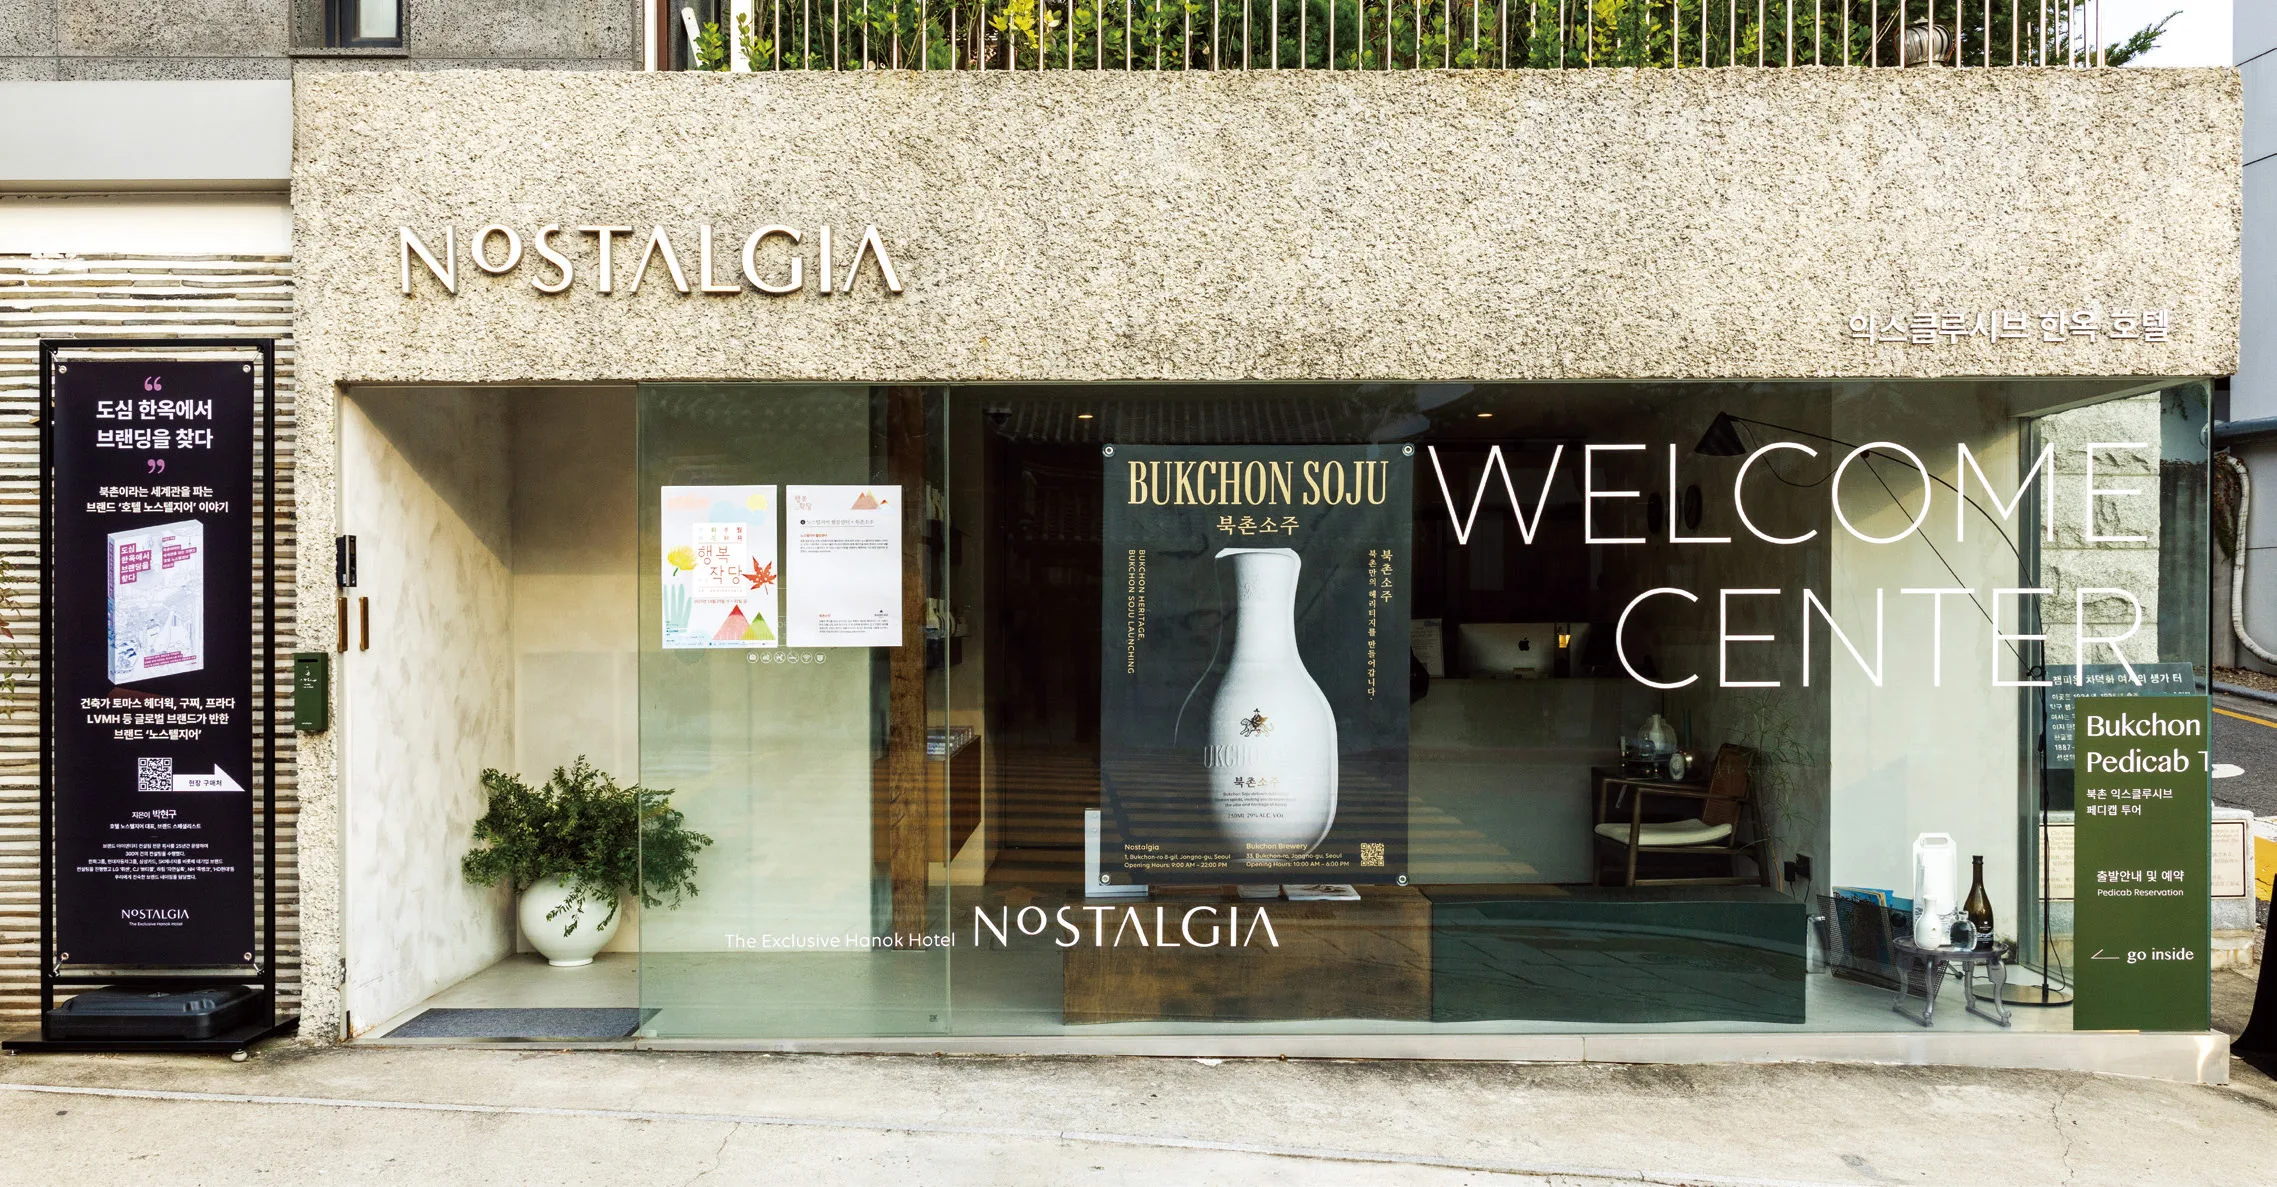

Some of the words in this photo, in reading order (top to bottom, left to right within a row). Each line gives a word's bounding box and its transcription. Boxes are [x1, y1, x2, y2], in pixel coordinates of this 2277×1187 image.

[400, 223, 902, 295] NOSTALGIA
[1849, 311, 2029, 346] 익스클루시브
[2040, 309, 2099, 344] 한옥
[2110, 308, 2169, 344] 호텔
[96, 399, 133, 420] 도심
[138, 399, 213, 420] 한옥에서
[96, 428, 171, 450] 브랜딩을
[175, 428, 214, 450] 찾다
[99, 486, 149, 498] 북촌이라는
[150, 486, 191, 498] 세계관을
[192, 486, 214, 498] 파는
[1128, 460, 1294, 506] BUKCHON
[1302, 460, 1389, 506] SOJU
[1427, 441, 2150, 546] WELCOME
[86, 501, 117, 514] 브랜드
[198, 501, 229, 514] 이야기
[1216, 515, 1300, 536] 북촌소주
[697, 544, 731, 566] 행복
[709, 564, 743, 585] 작당
[1128, 549, 1136, 593] BUKCHON
[1138, 549, 1146, 593] BUKCHON
[1368, 549, 1377, 587] 북촌만의
[1380, 549, 1393, 603] 북촌소주
[1367, 589, 1377, 637] 헤리티지를
[1127, 621, 1135, 674] LAUNCHING
[1615, 587, 2143, 690] CENTER
[2150, 673, 2170, 684] 생가
[2172, 673, 2182, 683] 터
[81, 698, 110, 709] 건축가
[112, 698, 142, 709] 토마스
[205, 698, 235, 709] 프라다
[87, 713, 121, 725] LVMH
[122, 713, 133, 725] 등
[134, 713, 165, 725] 글로벌
[166, 713, 207, 725] 브랜드가
[208, 713, 229, 725] 반한
[2087, 712, 2201, 737] Bukchon
[114, 729, 144, 741] 브랜드
[2087, 748, 2190, 773] Pedicab
[1234, 776, 1280, 789] 북촌소주
[2086, 788, 2107, 800] 북촌
[2110, 788, 2173, 800] 익스클루시브
[152, 809, 178, 820] 박현구
[2086, 804, 2118, 816] 페디캡
[2120, 804, 2142, 816] 투어
[1124, 843, 1160, 852] Nostalgia
[1246, 842, 1278, 850] Bukchon
[1278, 842, 1308, 850] Brewery
[1185, 862, 1196, 870] AM
[1217, 862, 1228, 870] PM
[1310, 861, 1320, 869] AM
[1339, 861, 1350, 869] PM
[2096, 869, 2142, 882] 출발안내
[2146, 869, 2157, 882] 및
[2161, 869, 2185, 882] 예약
[2097, 888, 2132, 897] Pedicab
[2133, 888, 2184, 897] Reservation
[121, 908, 190, 920] NOSTALGIA
[974, 904, 1280, 947] NOSTALGIA
[724, 932, 758, 949] The
[762, 932, 841, 949] Exclusive
[845, 932, 904, 949] Hanok
[908, 932, 956, 949] Hotel
[2127, 951, 2147, 964] go
[2151, 947, 2194, 961] inside
